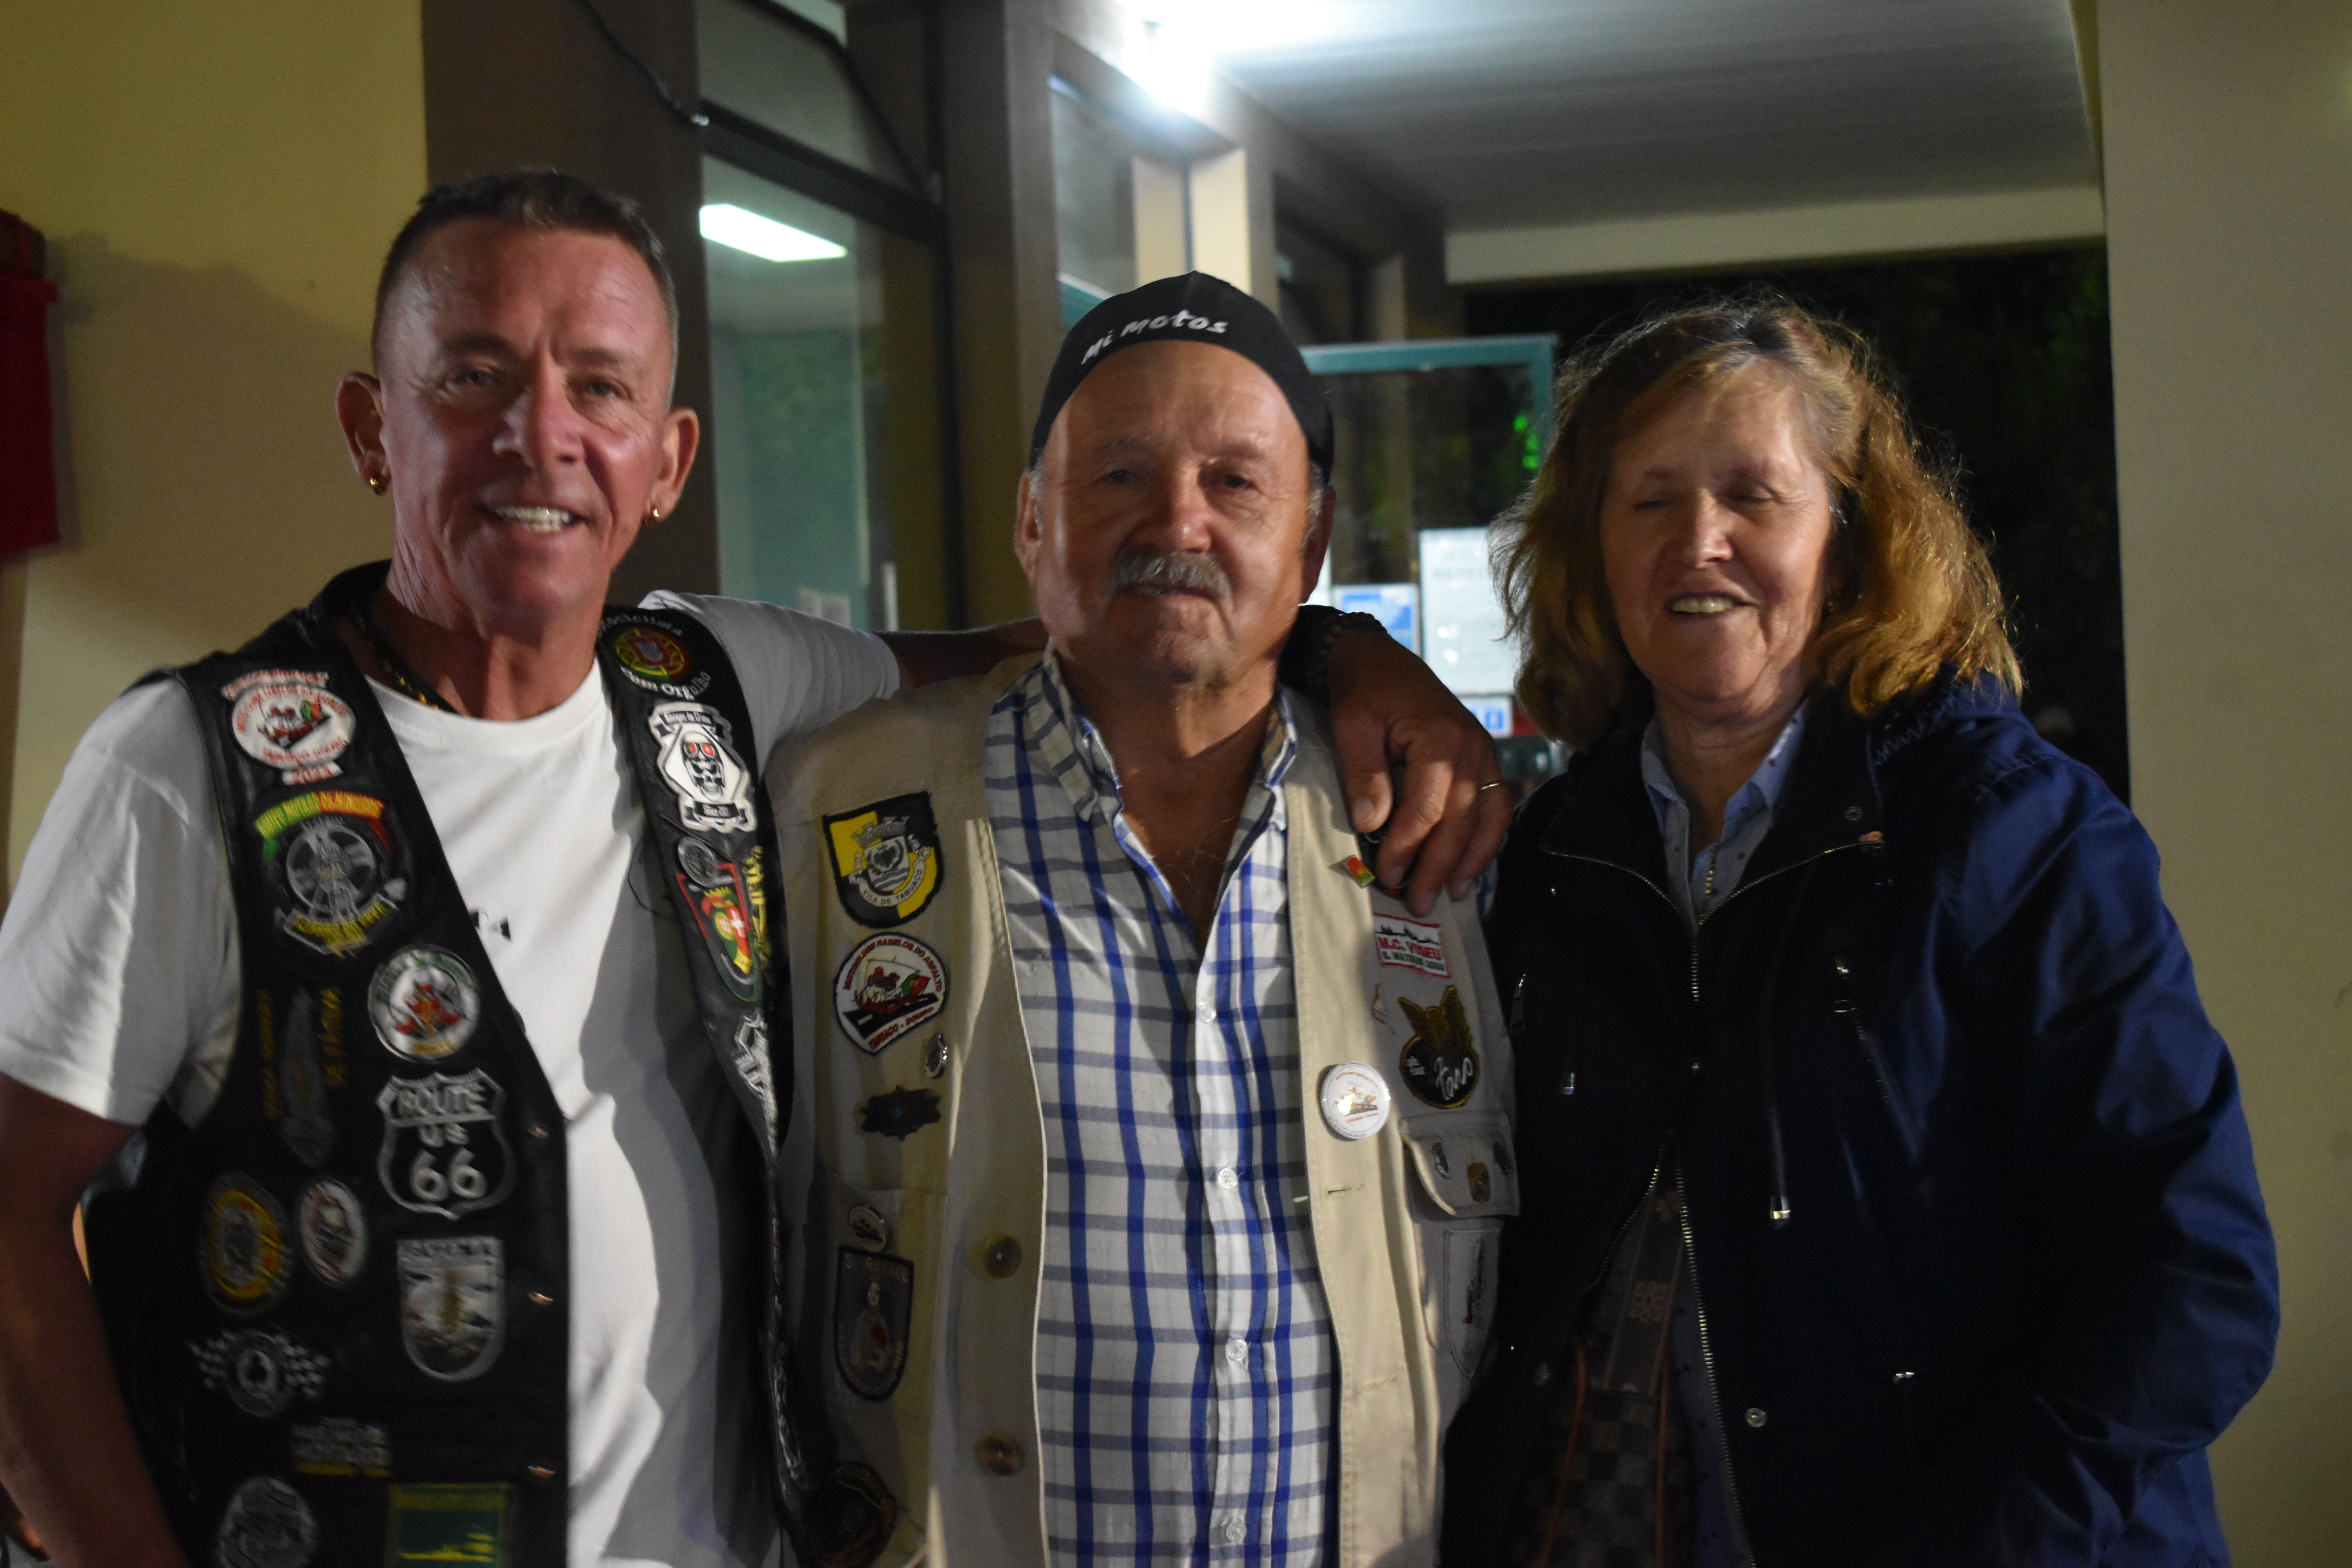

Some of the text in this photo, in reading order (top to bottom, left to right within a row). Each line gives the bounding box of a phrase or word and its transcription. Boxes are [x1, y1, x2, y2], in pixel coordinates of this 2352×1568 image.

[863, 888, 877, 903] VILA
[397, 1082, 491, 1118] ROUTE
[410, 1147, 489, 1202] 66
